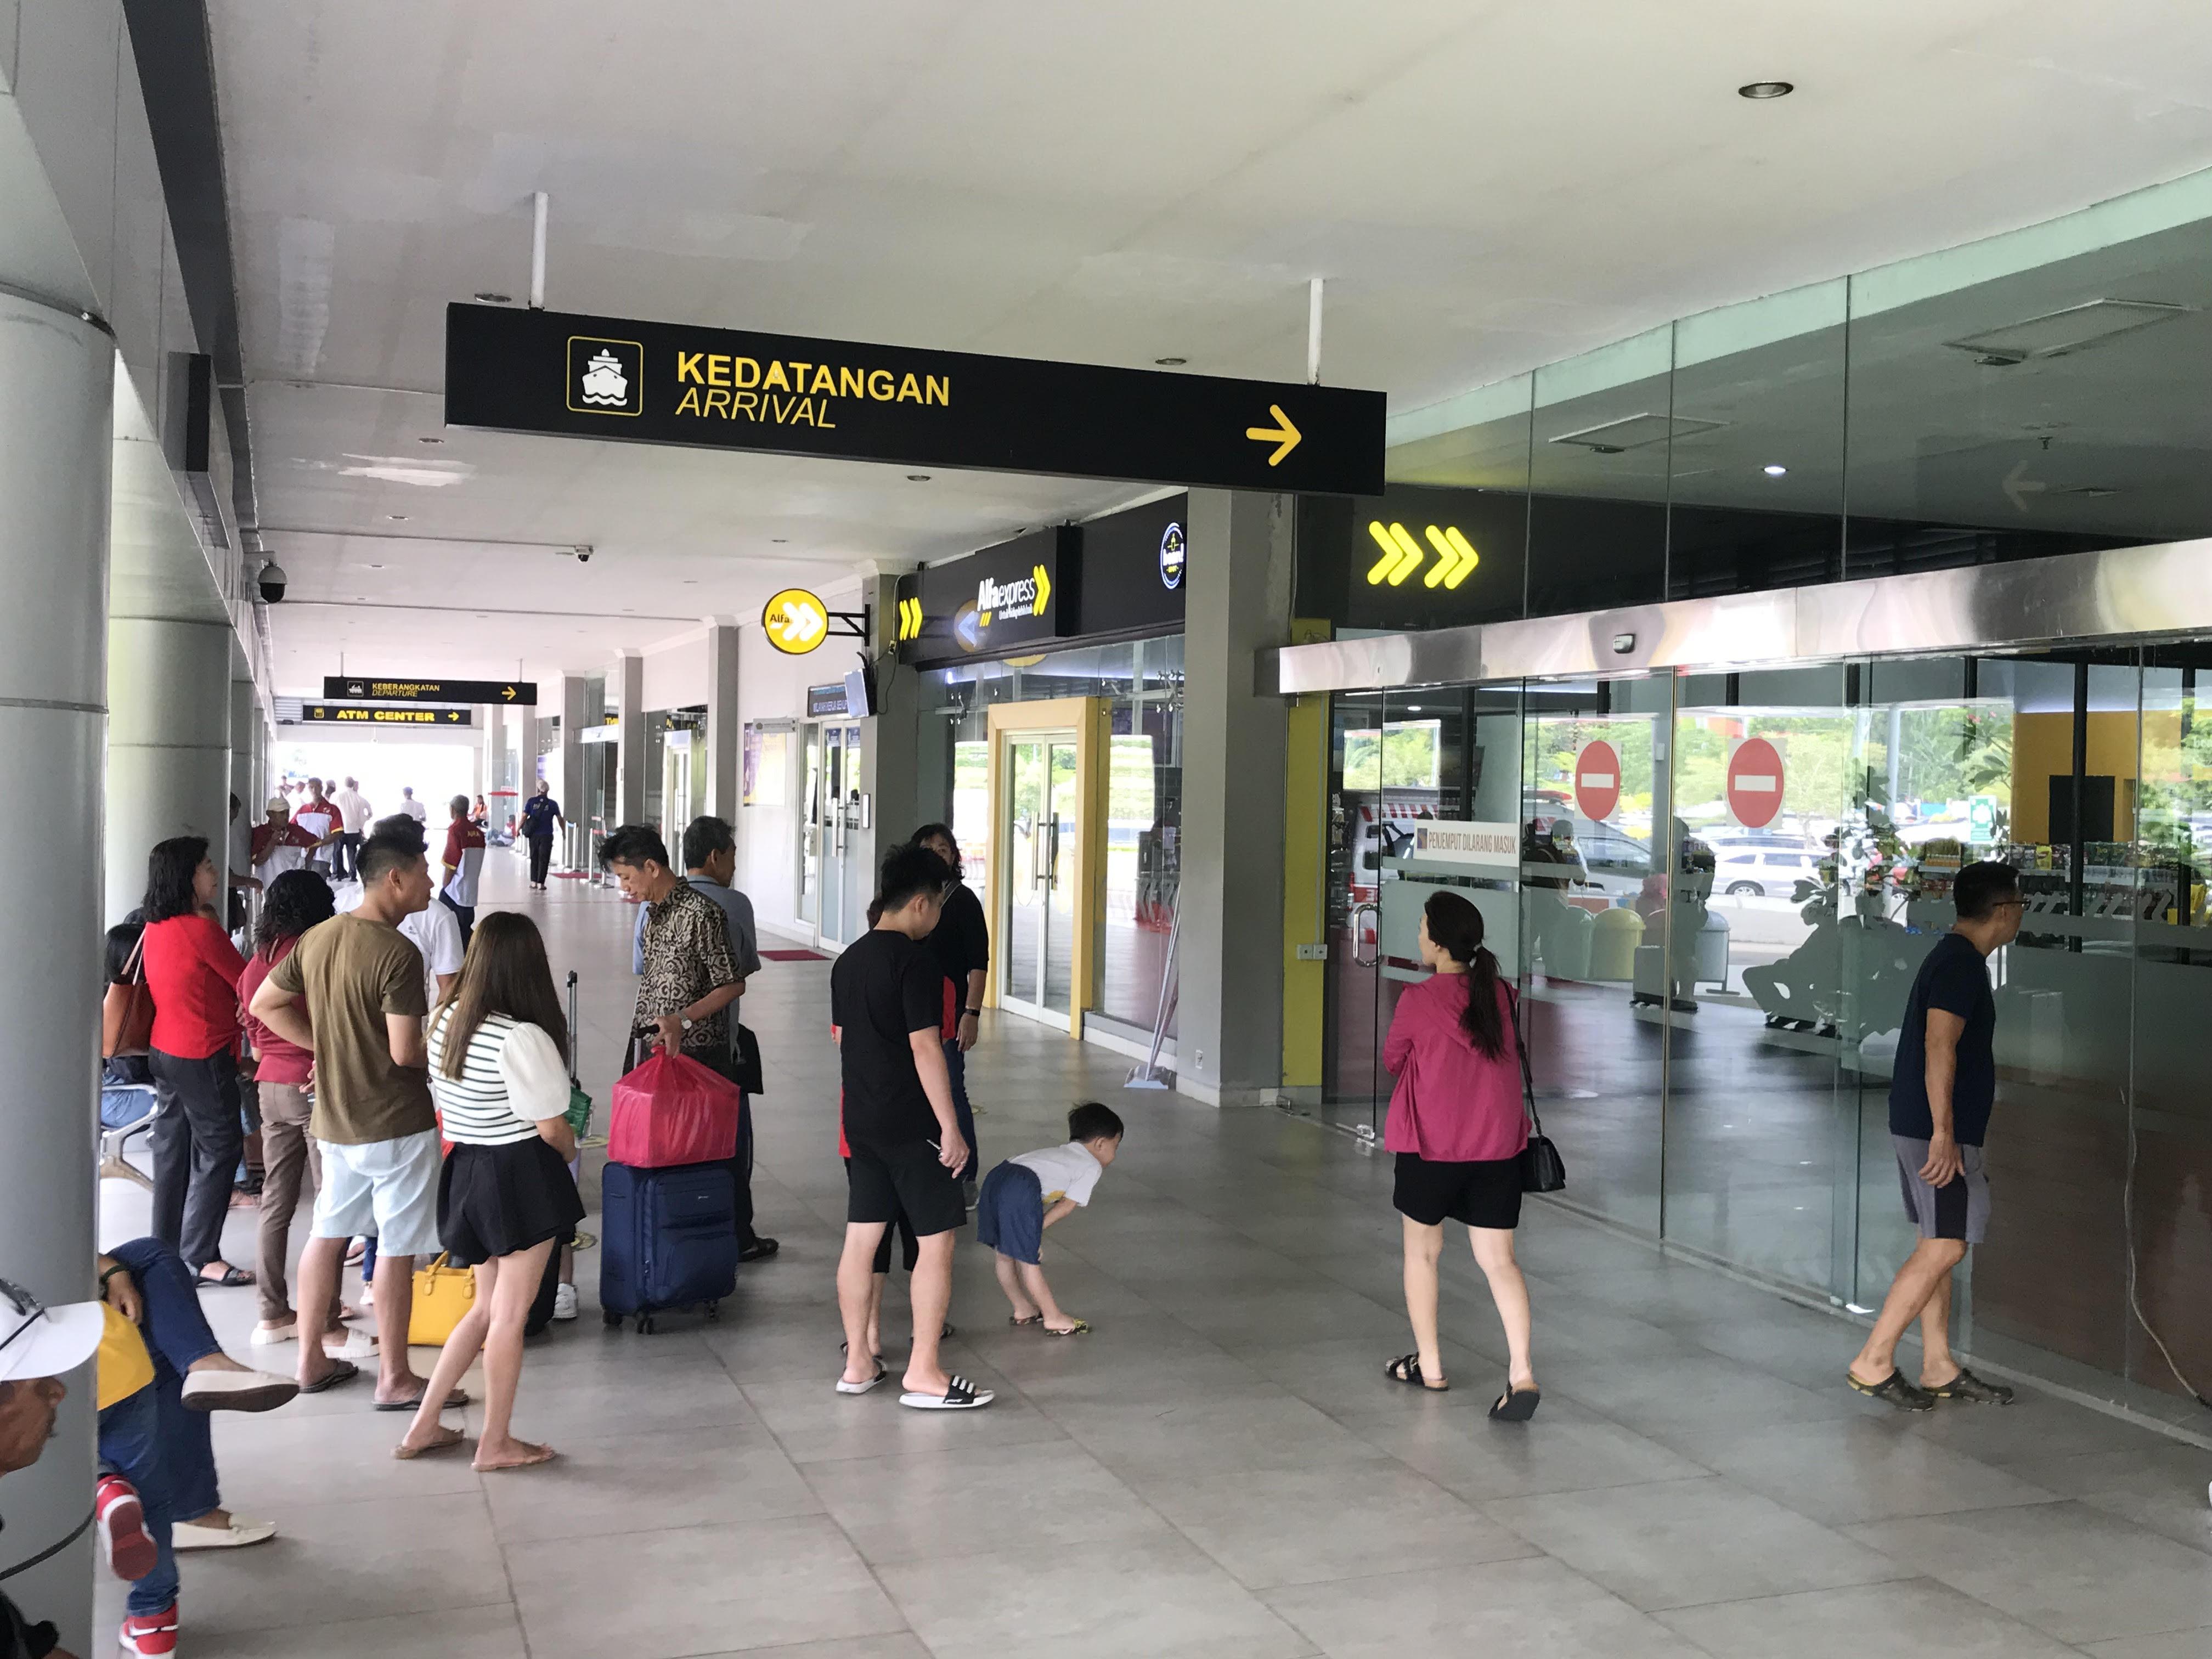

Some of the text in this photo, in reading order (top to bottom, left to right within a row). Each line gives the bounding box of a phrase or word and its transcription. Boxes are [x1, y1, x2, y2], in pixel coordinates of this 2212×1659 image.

[678, 351, 949, 406] KEDATANGAN
[675, 387, 836, 428] ARRIVAL
[372, 683, 440, 691] KEBERANGKATAN
[337, 710, 435, 721] ATM CENTER
[1429, 832, 1516, 854] PENJEMPUT DILARANG MASUK
